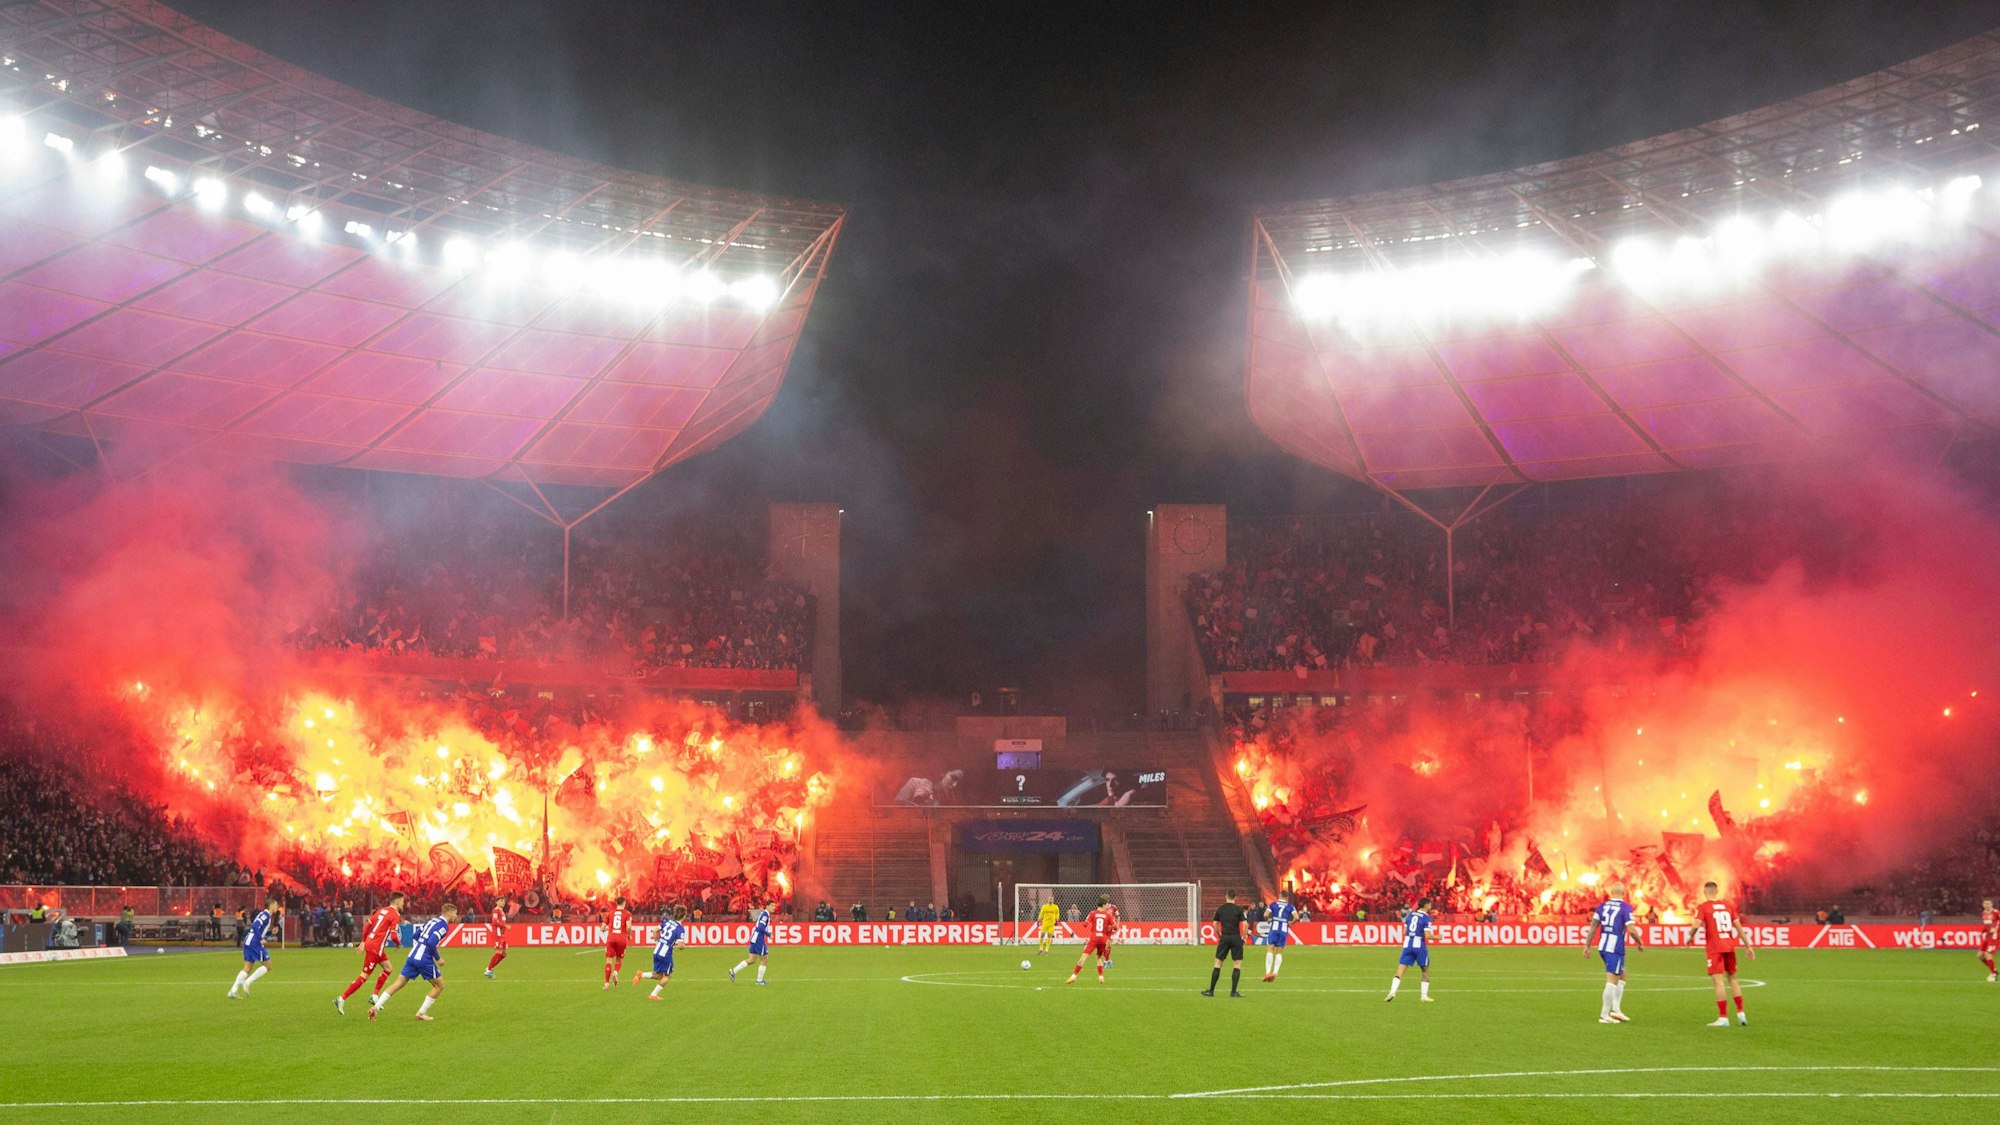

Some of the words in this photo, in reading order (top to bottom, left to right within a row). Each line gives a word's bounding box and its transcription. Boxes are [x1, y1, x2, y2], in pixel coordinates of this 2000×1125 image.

[1138, 772, 1166, 784] MILES
[1278, 904, 1286, 918] 7
[1600, 905, 1621, 926] 37
[612, 915, 622, 929] 6
[1096, 918, 1104, 932] 8
[1409, 915, 1418, 931] 8
[1713, 911, 1732, 932] 19
[462, 928, 487, 944] WTG
[527, 926, 609, 944] LEADIN
[809, 925, 852, 943] FOR
[859, 925, 998, 943] ENTERPRISE
[660, 922, 677, 940] 33
[1321, 925, 1403, 943] LEADIN
[1649, 926, 1790, 945] ENTERISE
[1829, 929, 1854, 946] WTG
[1893, 928, 1987, 949] wtg.com
